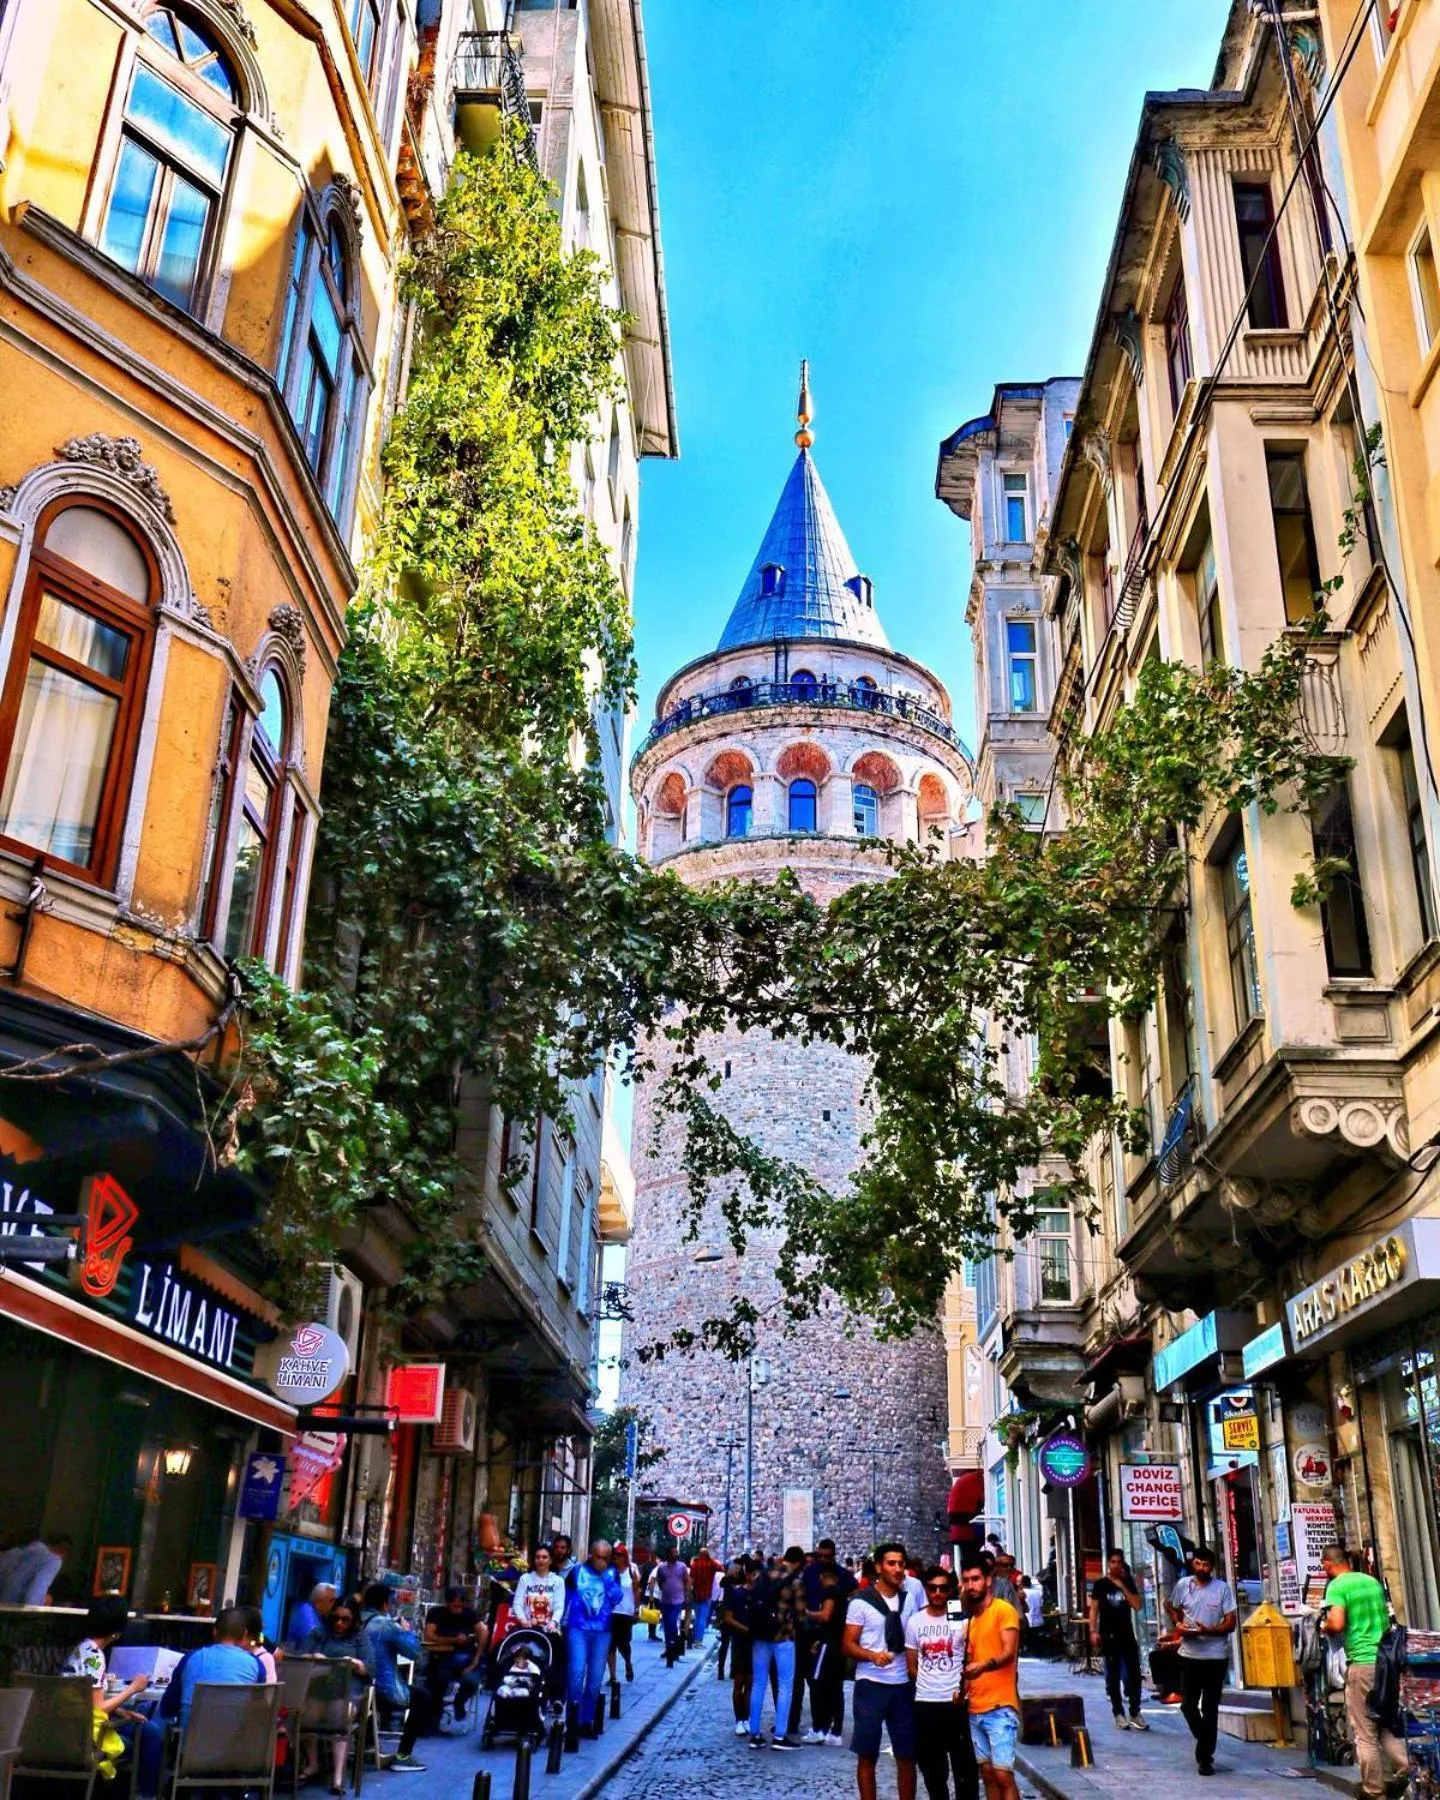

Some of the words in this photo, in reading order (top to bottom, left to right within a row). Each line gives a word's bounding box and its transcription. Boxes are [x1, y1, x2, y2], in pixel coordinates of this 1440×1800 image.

[135, 1264, 239, 1368] LİMANI
[1294, 1280, 1337, 1341] ARAS
[279, 1358, 329, 1374] KAHVE
[1133, 1467, 1173, 1480] DÖVİZ
[1126, 1482, 1182, 1494] CHANGE
